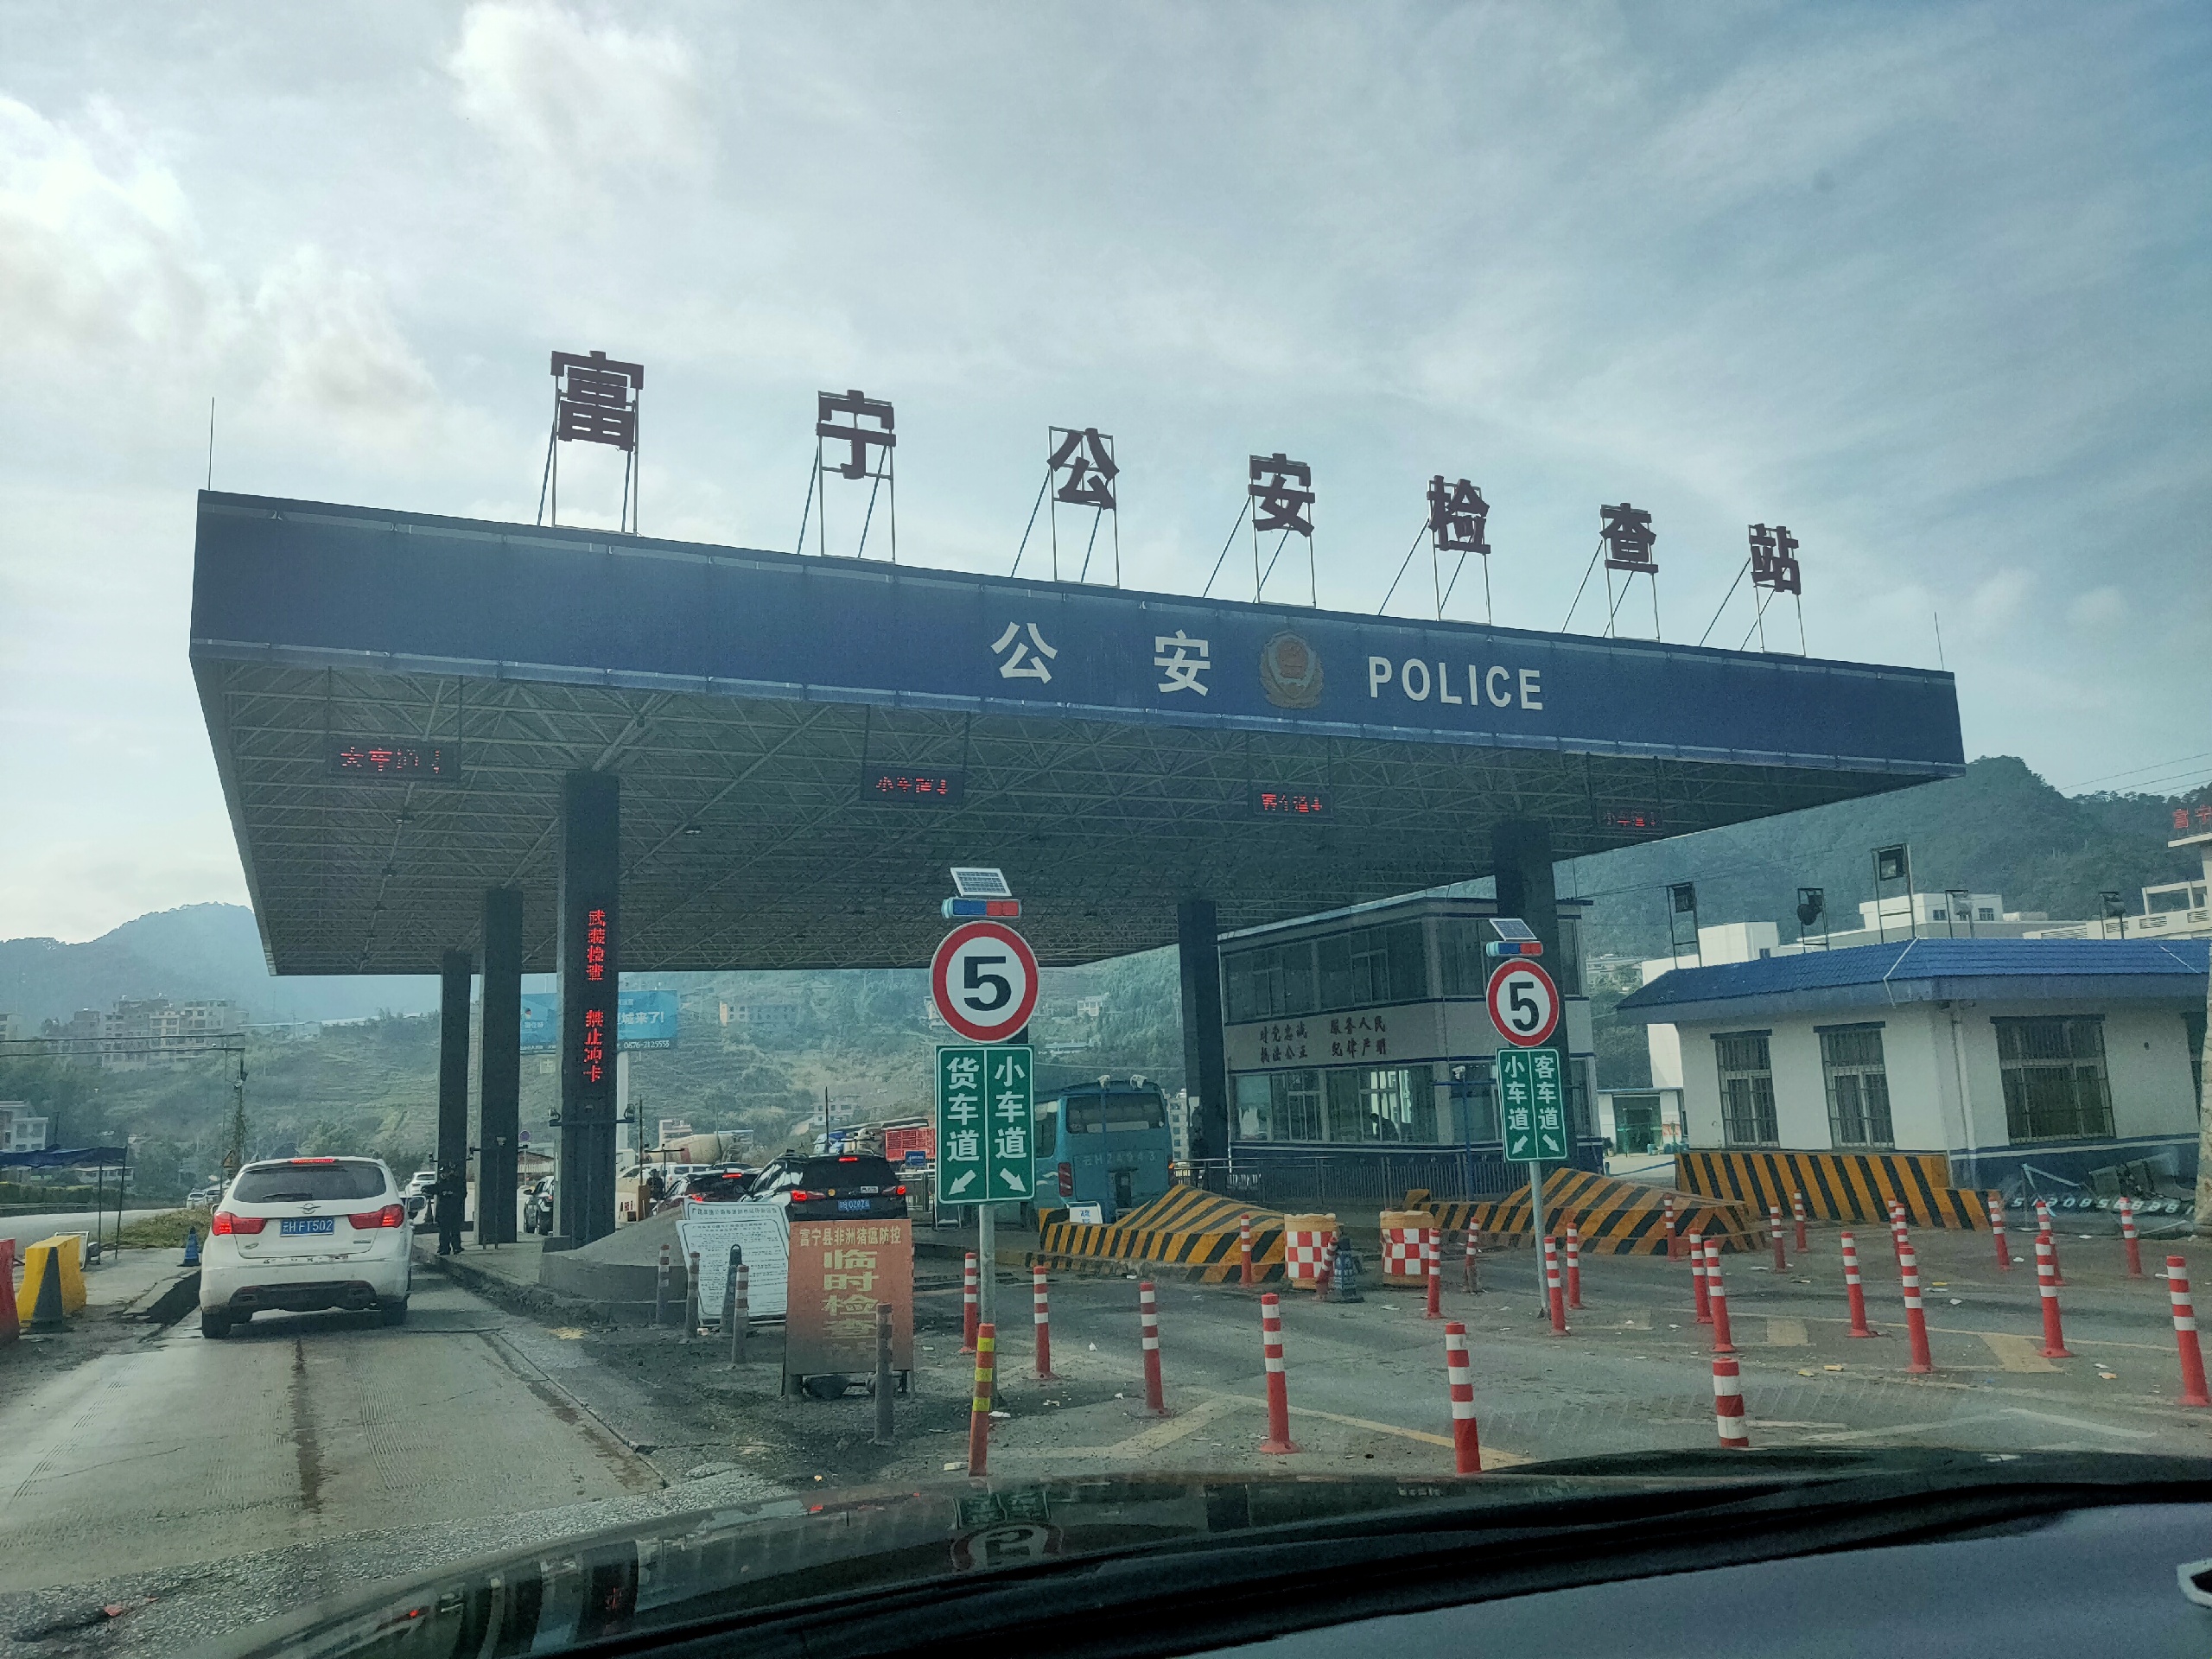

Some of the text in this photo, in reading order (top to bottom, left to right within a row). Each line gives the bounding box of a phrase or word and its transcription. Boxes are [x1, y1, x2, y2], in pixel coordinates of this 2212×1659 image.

[550, 350, 1802, 596] 富宁公安检查站
[990, 621, 1210, 696] 公安
[1369, 656, 1543, 710] POLICE
[583, 909, 607, 1083] 武装检查 禁止冲卡
[617, 1011, 664, 1026] 城来了!
[963, 956, 1012, 1012] 5
[1509, 981, 1540, 1032] 5
[1331, 1015, 1386, 1035] 服务人民
[946, 1056, 981, 1163] 货车道
[994, 1055, 1027, 1160] 小车道
[1503, 1055, 1530, 1131] 小车道
[1534, 1054, 1560, 1130] 客车道
[799, 1225, 902, 1247] 富宁县非洲猪瘟防控
